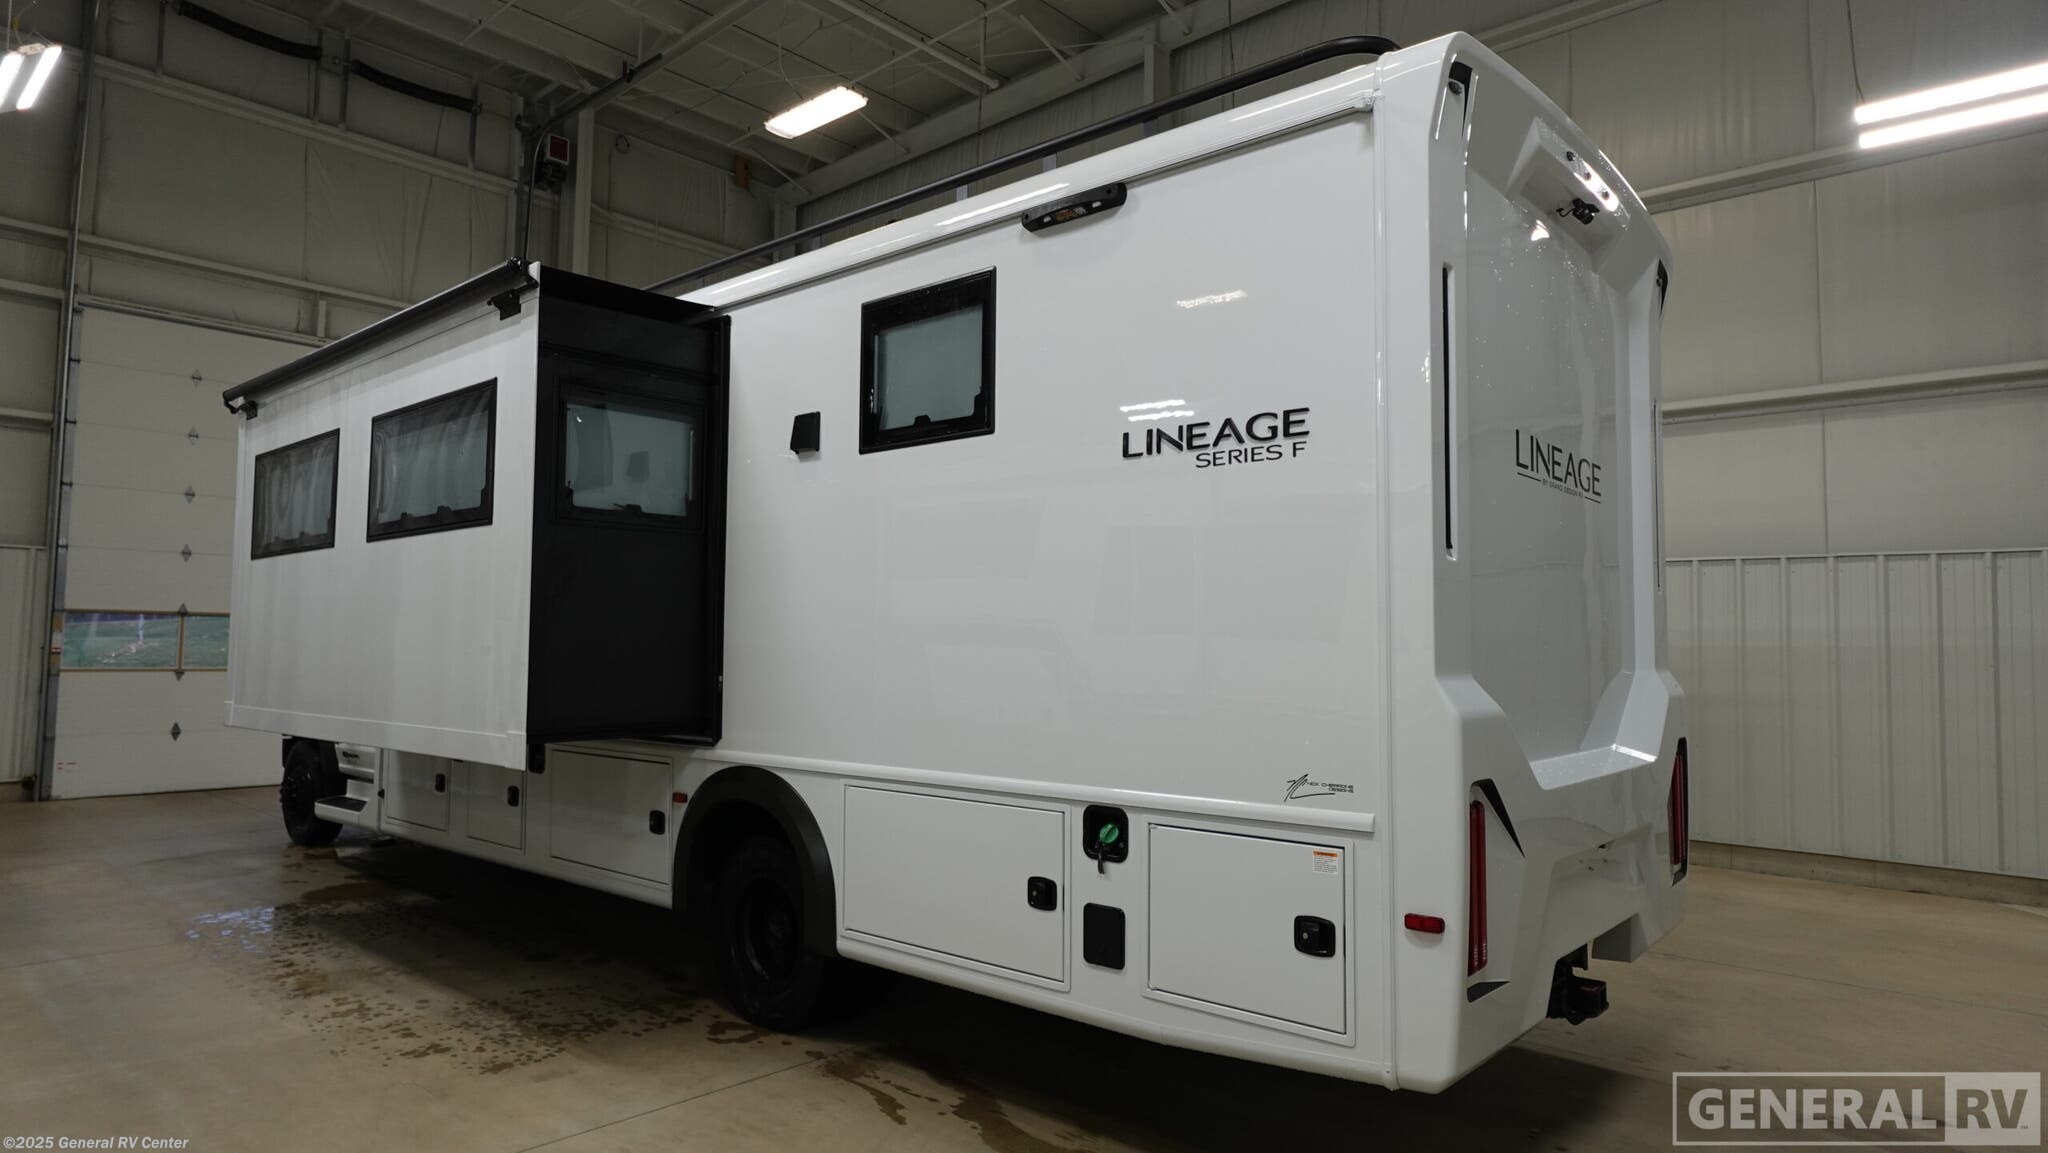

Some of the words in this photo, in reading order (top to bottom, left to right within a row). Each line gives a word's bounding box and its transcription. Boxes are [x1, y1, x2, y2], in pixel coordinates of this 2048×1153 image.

[1122, 407, 1310, 458] LINEAGE
[1195, 444, 1283, 468] SERIES
[1292, 441, 1308, 458] F
[1515, 429, 1601, 497] LINEAGE
